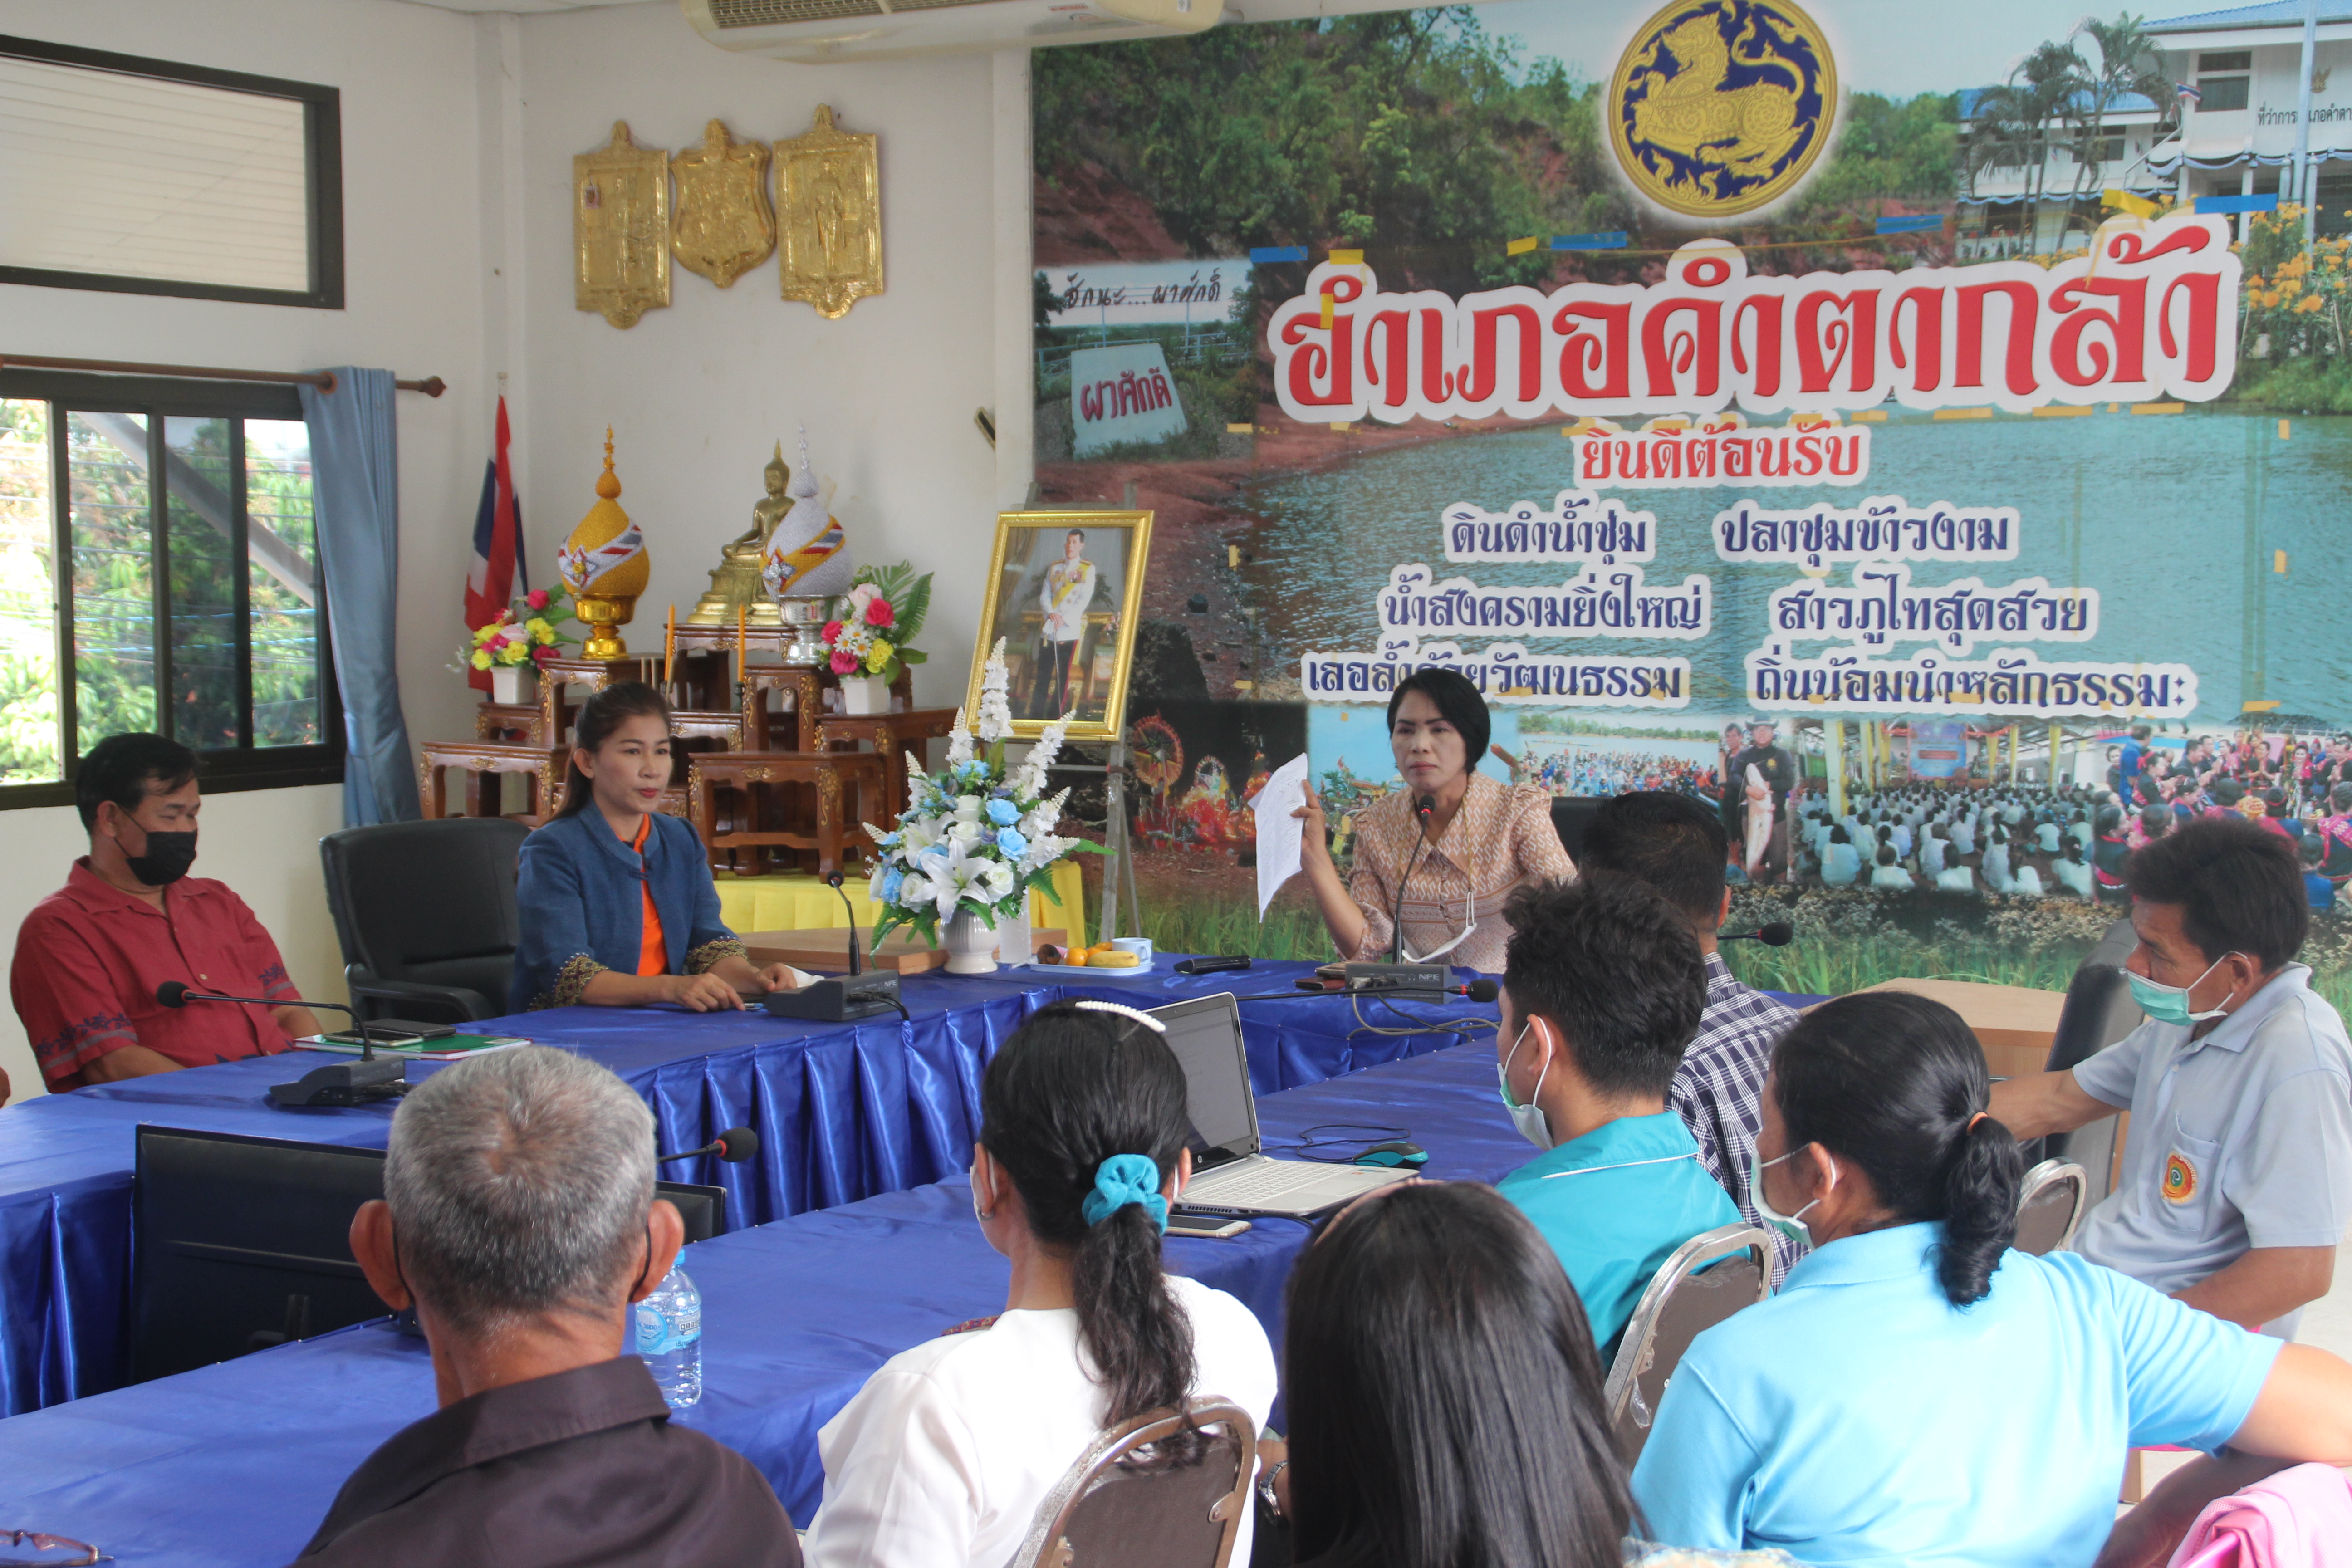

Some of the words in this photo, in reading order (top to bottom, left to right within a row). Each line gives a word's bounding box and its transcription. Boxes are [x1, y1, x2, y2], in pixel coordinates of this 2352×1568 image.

[1280, 225, 2221, 407] อำเภอคำตากล้า
[1582, 419, 1861, 479] ยินดีต้อนรับ
[1452, 497, 1646, 565] ดินดำน้ำชุ่ม
[1725, 505, 2009, 567] ปลาชุมข้าวงาม
[1385, 572, 1703, 630] น้ำสงครามยิ่งใหญ่
[1778, 572, 2088, 646] สาวภูไทสุดสวย
[1309, 640, 1681, 698] เลอล้ำ้ยวัฒนธรรม
[1754, 643, 2185, 708] ถิ่นน้อมนำหลักธรรมะ
